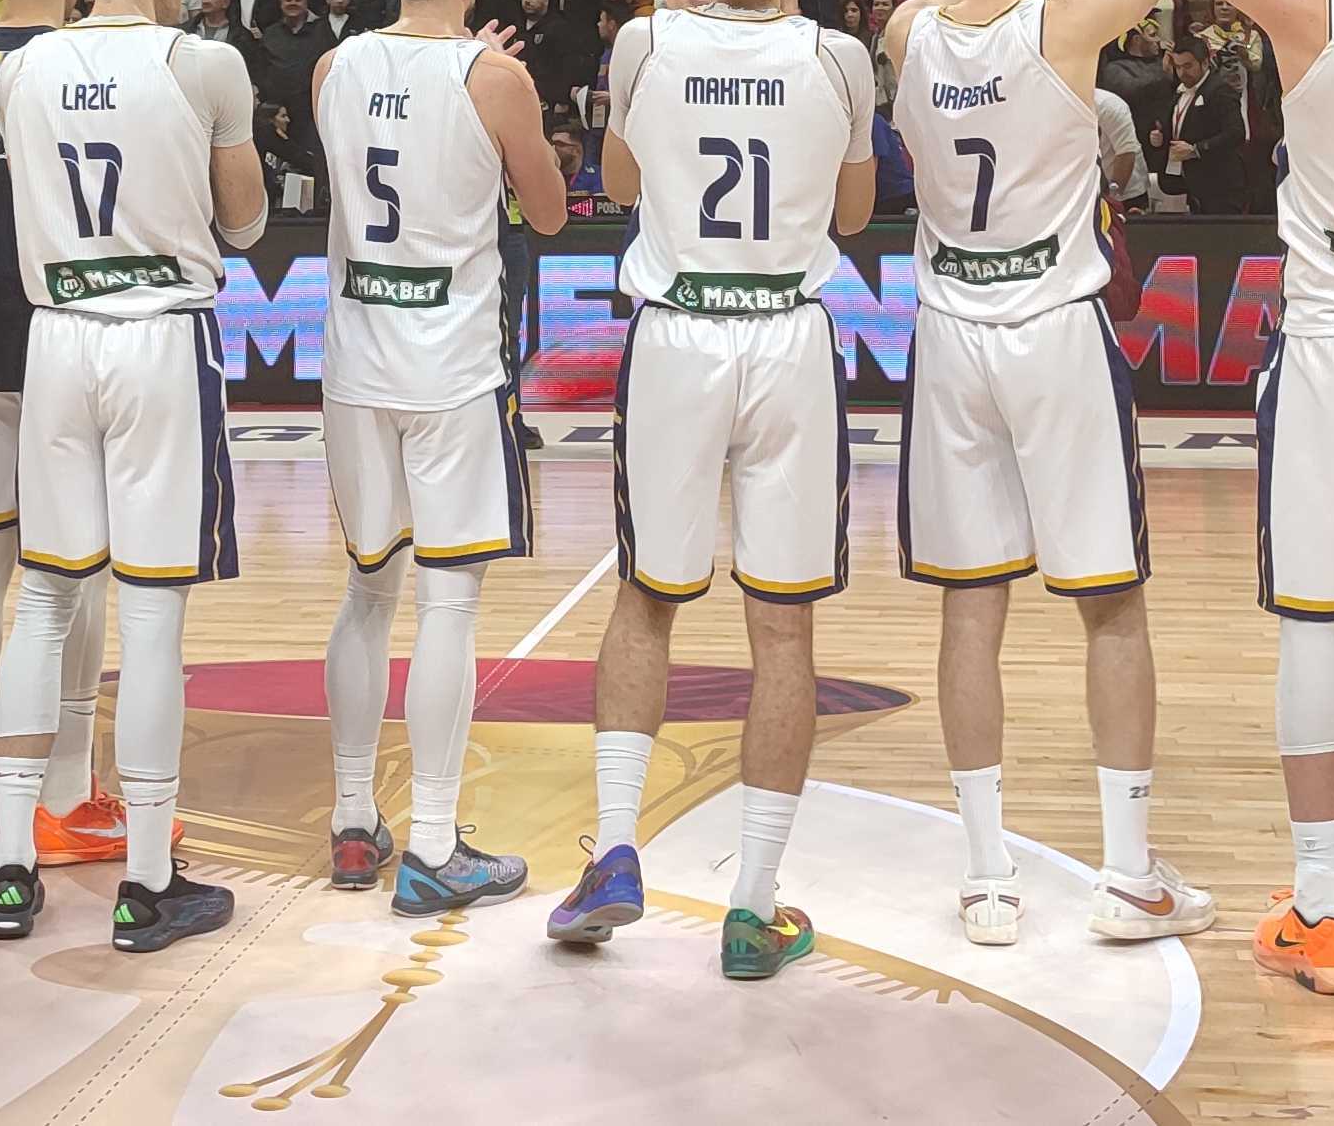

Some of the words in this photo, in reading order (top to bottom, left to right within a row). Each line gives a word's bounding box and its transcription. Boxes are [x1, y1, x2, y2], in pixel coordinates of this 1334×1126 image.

[62, 77, 118, 110] LAZIĆ
[368, 88, 411, 120] ATIĆ
[684, 76, 785, 106] MAKITAN
[57, 142, 123, 238] 17
[365, 146, 401, 243] 5
[698, 136, 771, 241] 21
[954, 137, 997, 232] 7
[962, 247, 1052, 281] MAXBET
[354, 274, 445, 302] MAXBET
[702, 285, 799, 311] MAXBET
